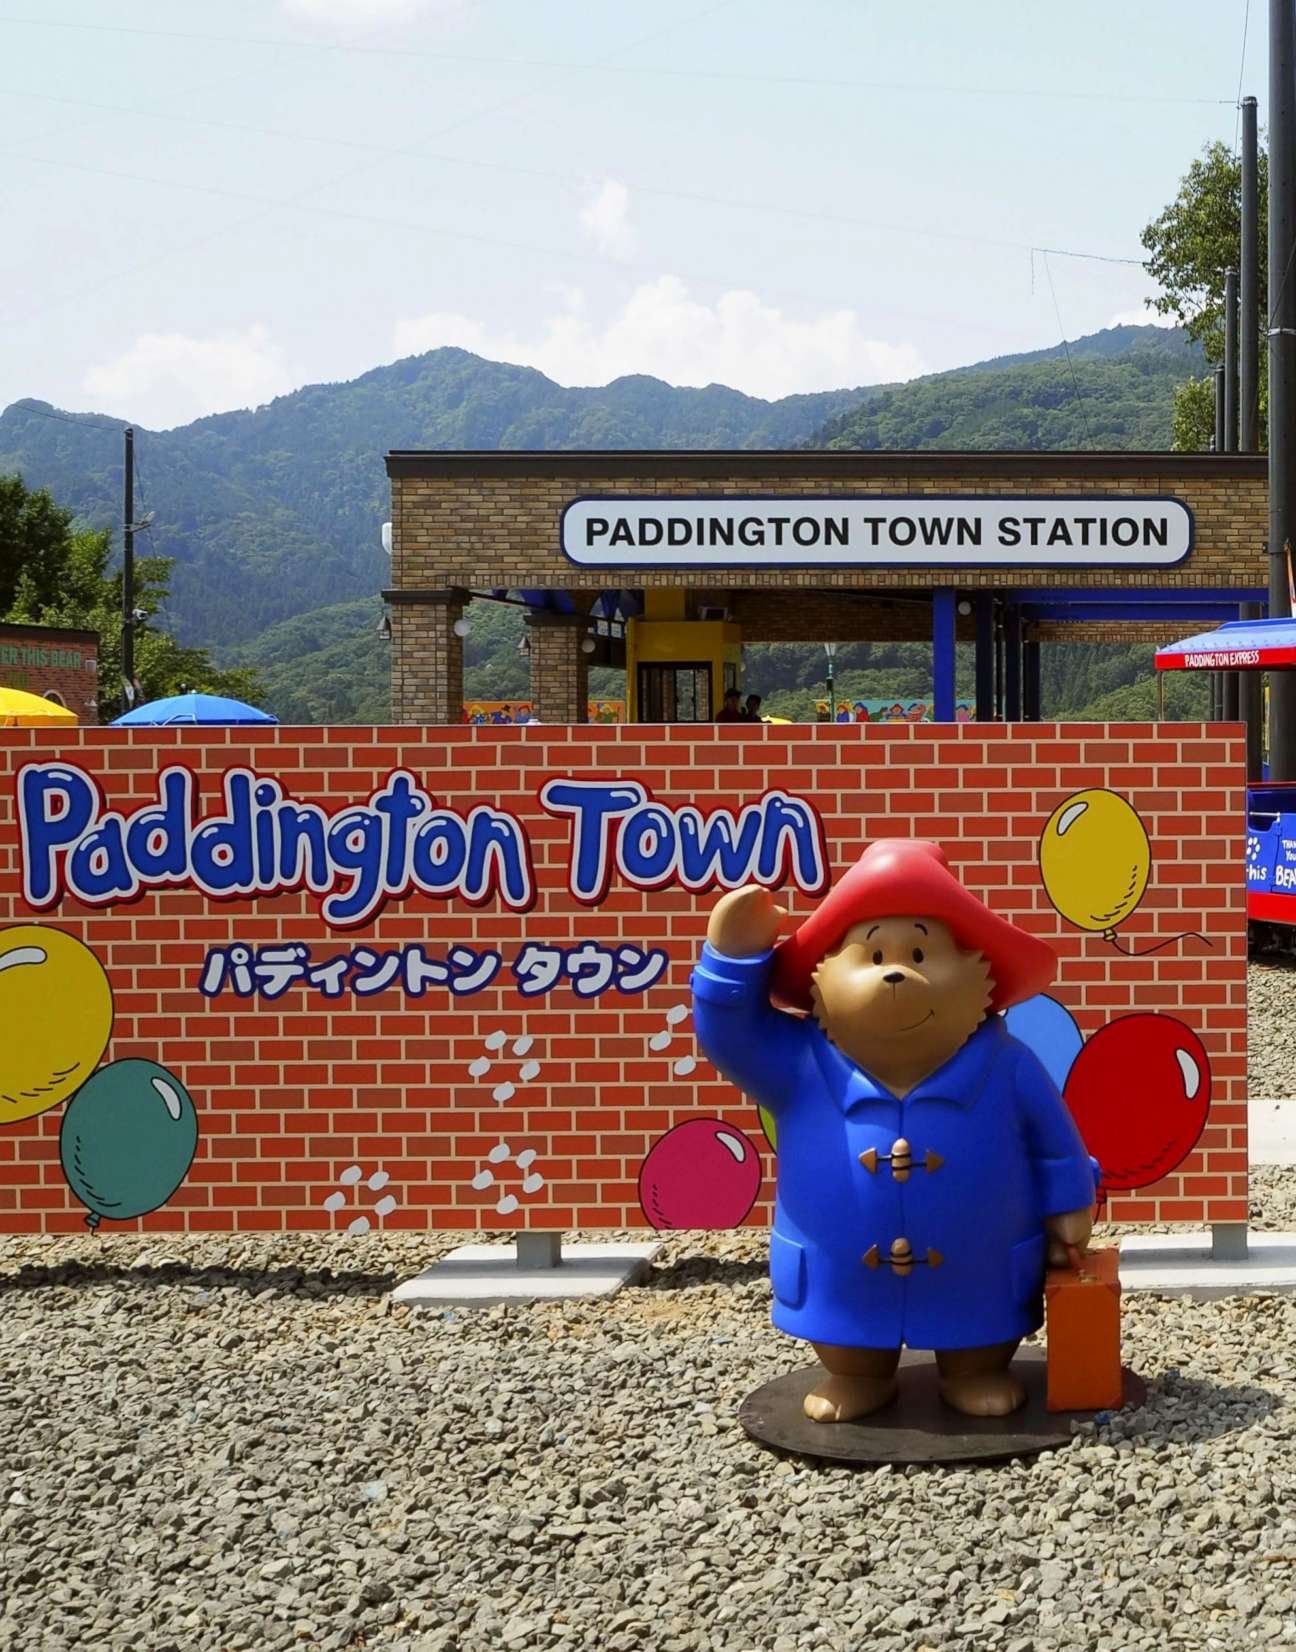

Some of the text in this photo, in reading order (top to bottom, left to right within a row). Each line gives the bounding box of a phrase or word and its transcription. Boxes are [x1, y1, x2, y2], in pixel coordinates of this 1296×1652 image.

[585, 516, 1169, 548] PADDINGTON TOWN STATION
[1184, 650, 1260, 667] PADDINGTON EXPRESS
[17, 762, 826, 925] Paddington Town
[202, 942, 667, 998] パディントン タウン
